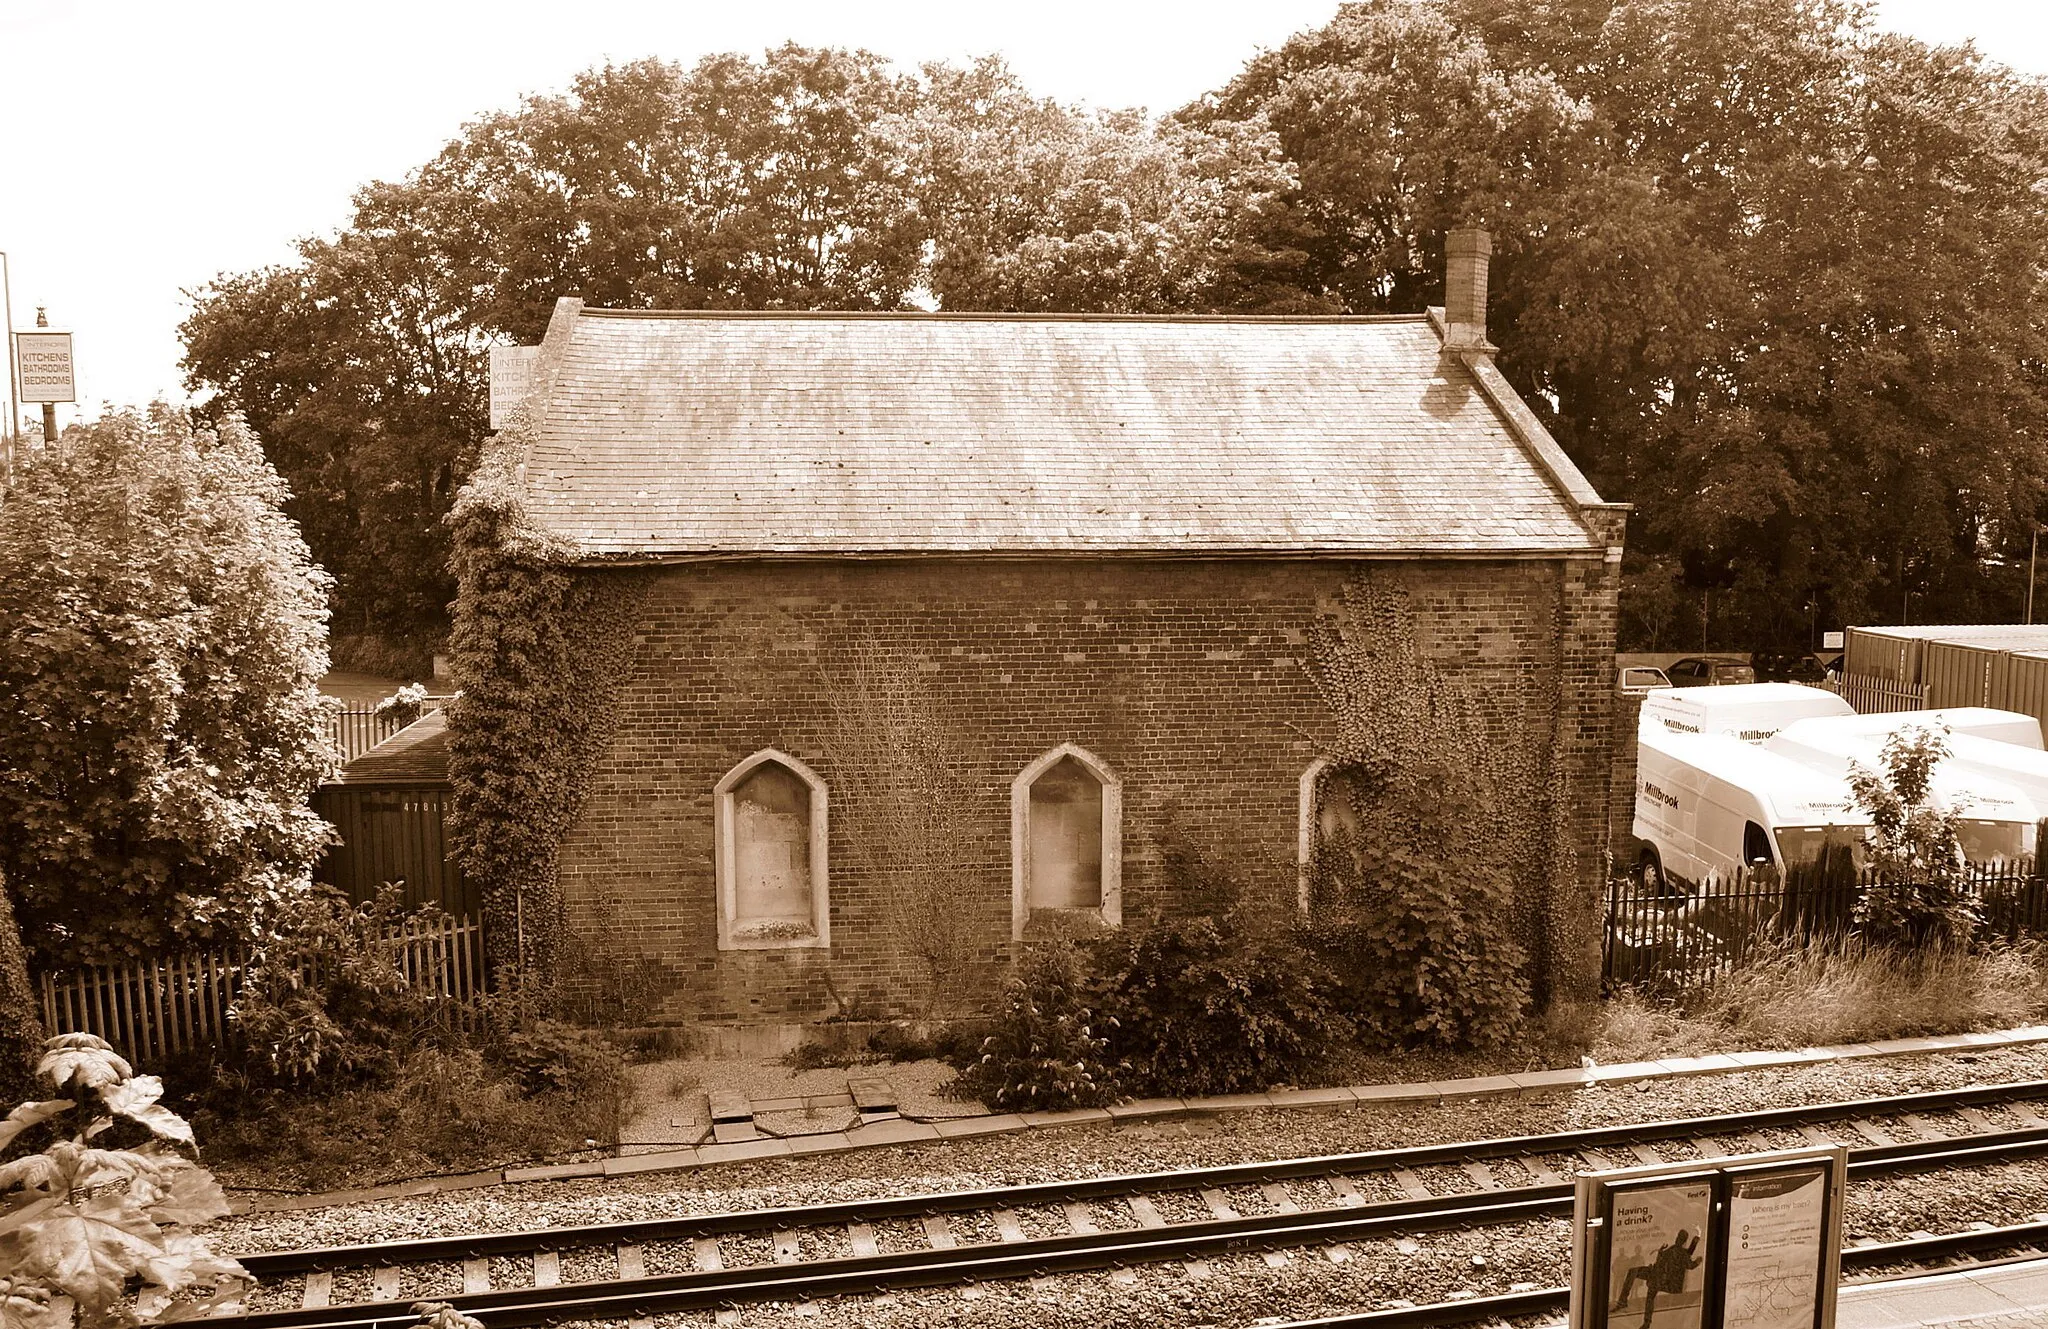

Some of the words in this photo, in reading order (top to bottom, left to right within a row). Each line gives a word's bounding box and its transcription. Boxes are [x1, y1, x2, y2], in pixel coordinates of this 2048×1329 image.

[22, 353, 69, 362] KITCHENS
[23, 364, 70, 373] BATHROOMS
[24, 376, 71, 385] BEDROOMS
[1663, 718, 1700, 734] Millbrook
[1645, 781, 1680, 810] Millbrook
[1617, 1206, 1649, 1217] Having
[1752, 1205, 1773, 1213] Where
[1616, 1219, 1622, 1227] a
[1624, 1215, 1653, 1226] drink?
